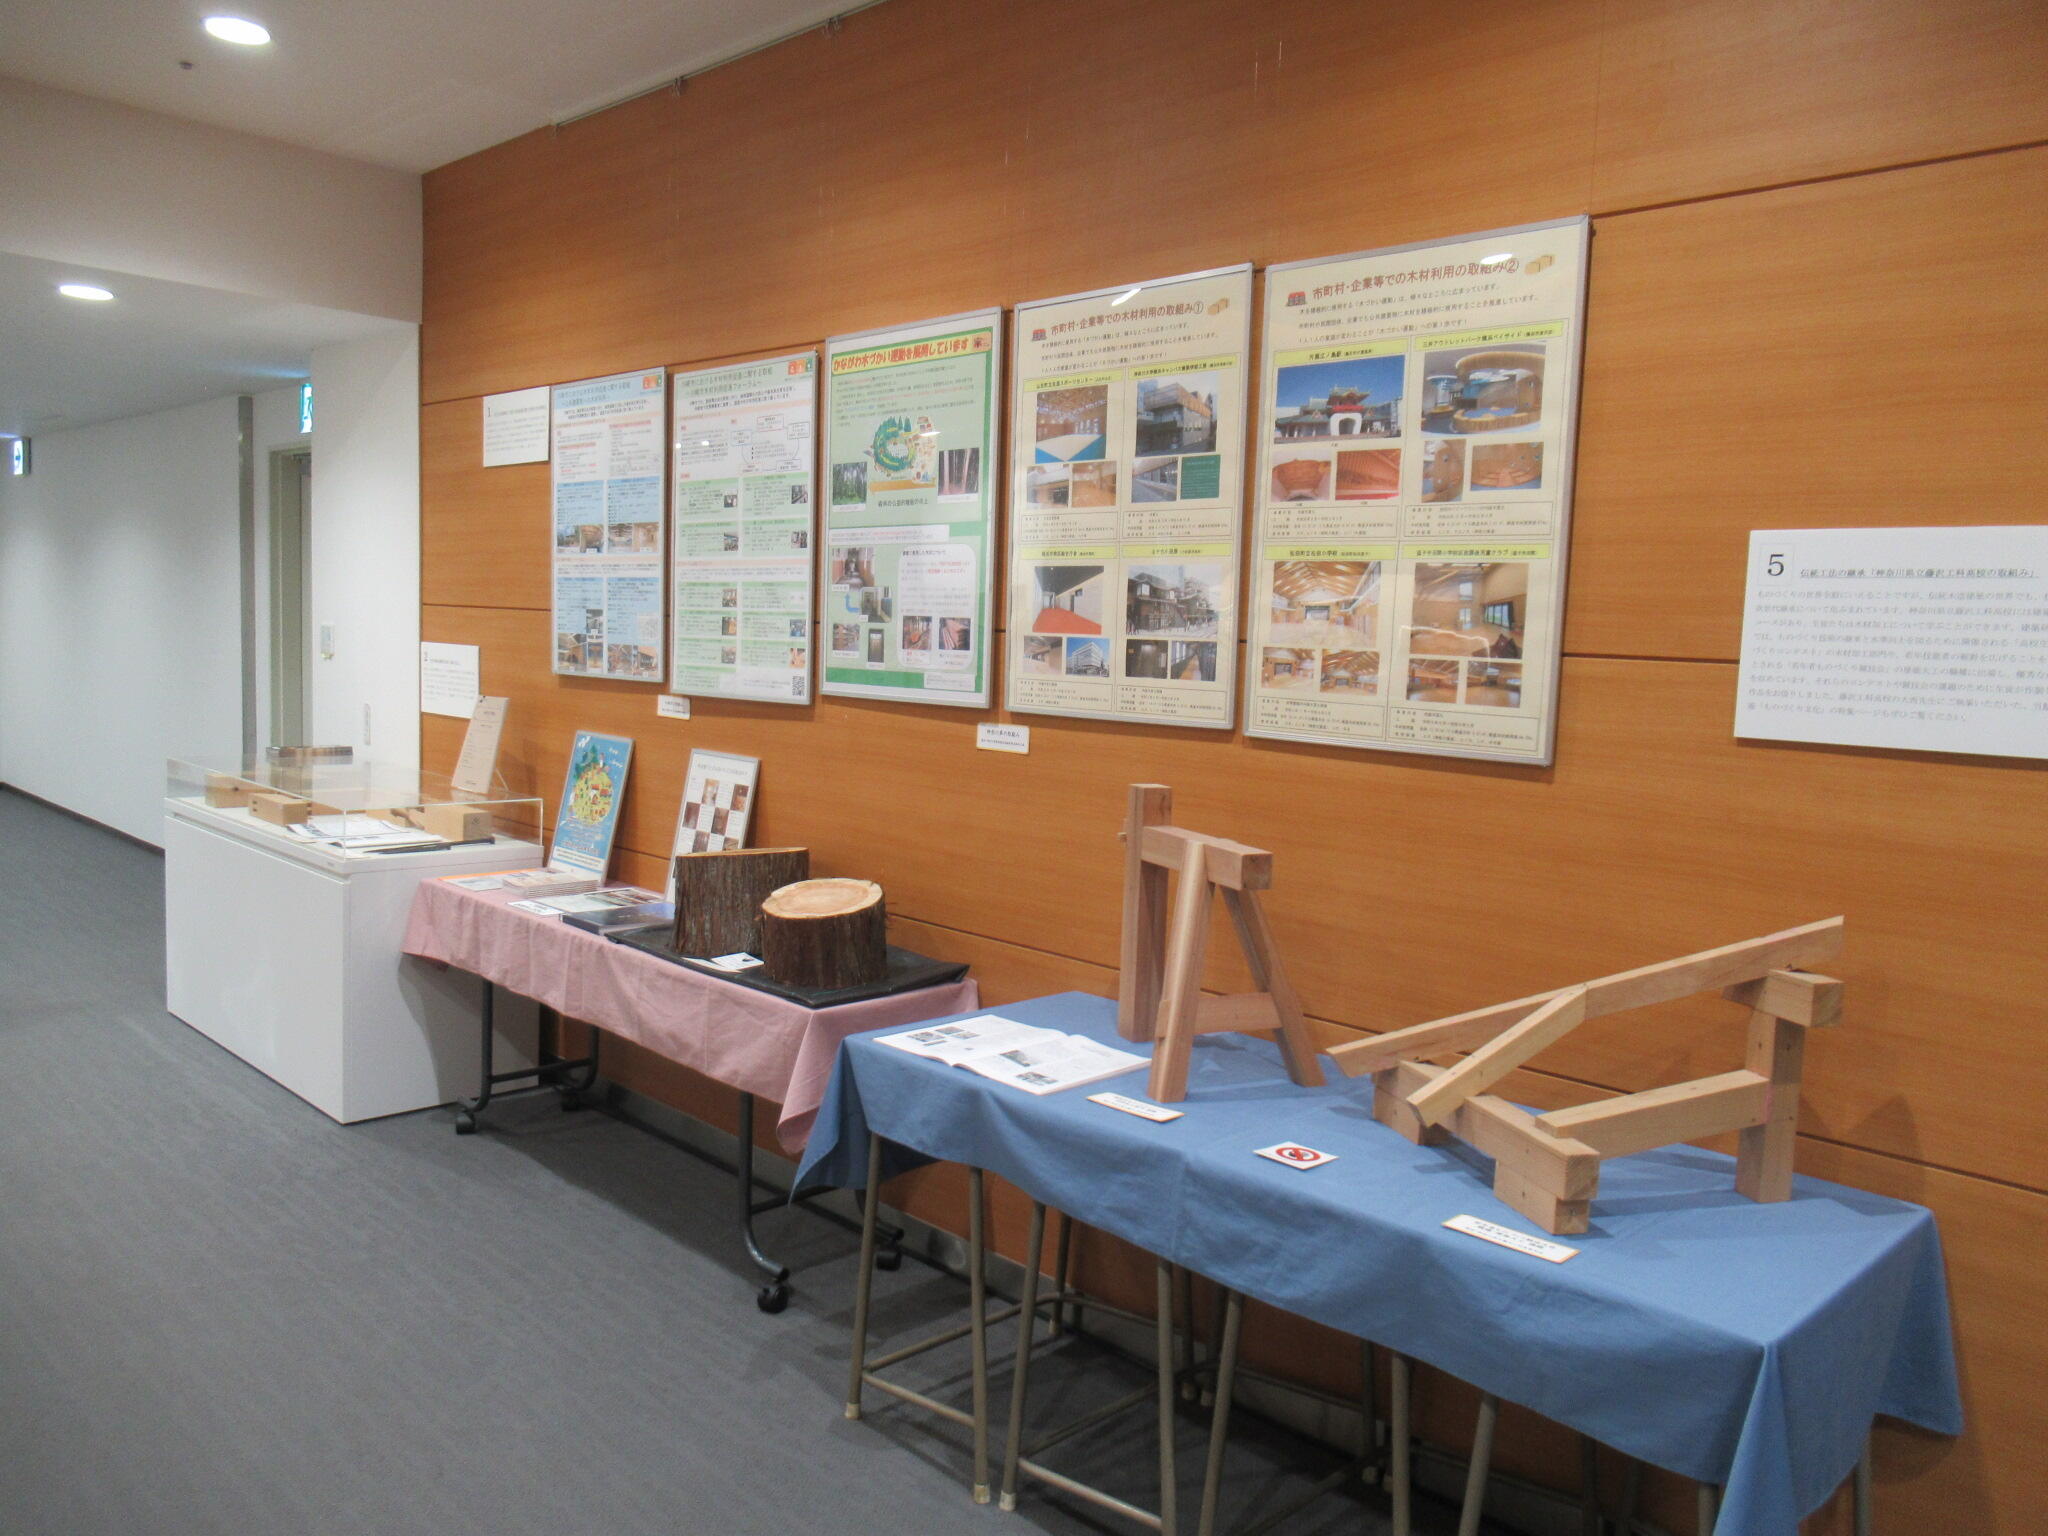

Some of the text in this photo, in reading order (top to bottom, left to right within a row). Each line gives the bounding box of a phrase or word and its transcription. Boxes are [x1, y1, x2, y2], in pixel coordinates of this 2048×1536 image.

[1051, 300, 1204, 336] 市町村・企業等での木材利用の取組み①
[1767, 554, 1784, 577] 5
